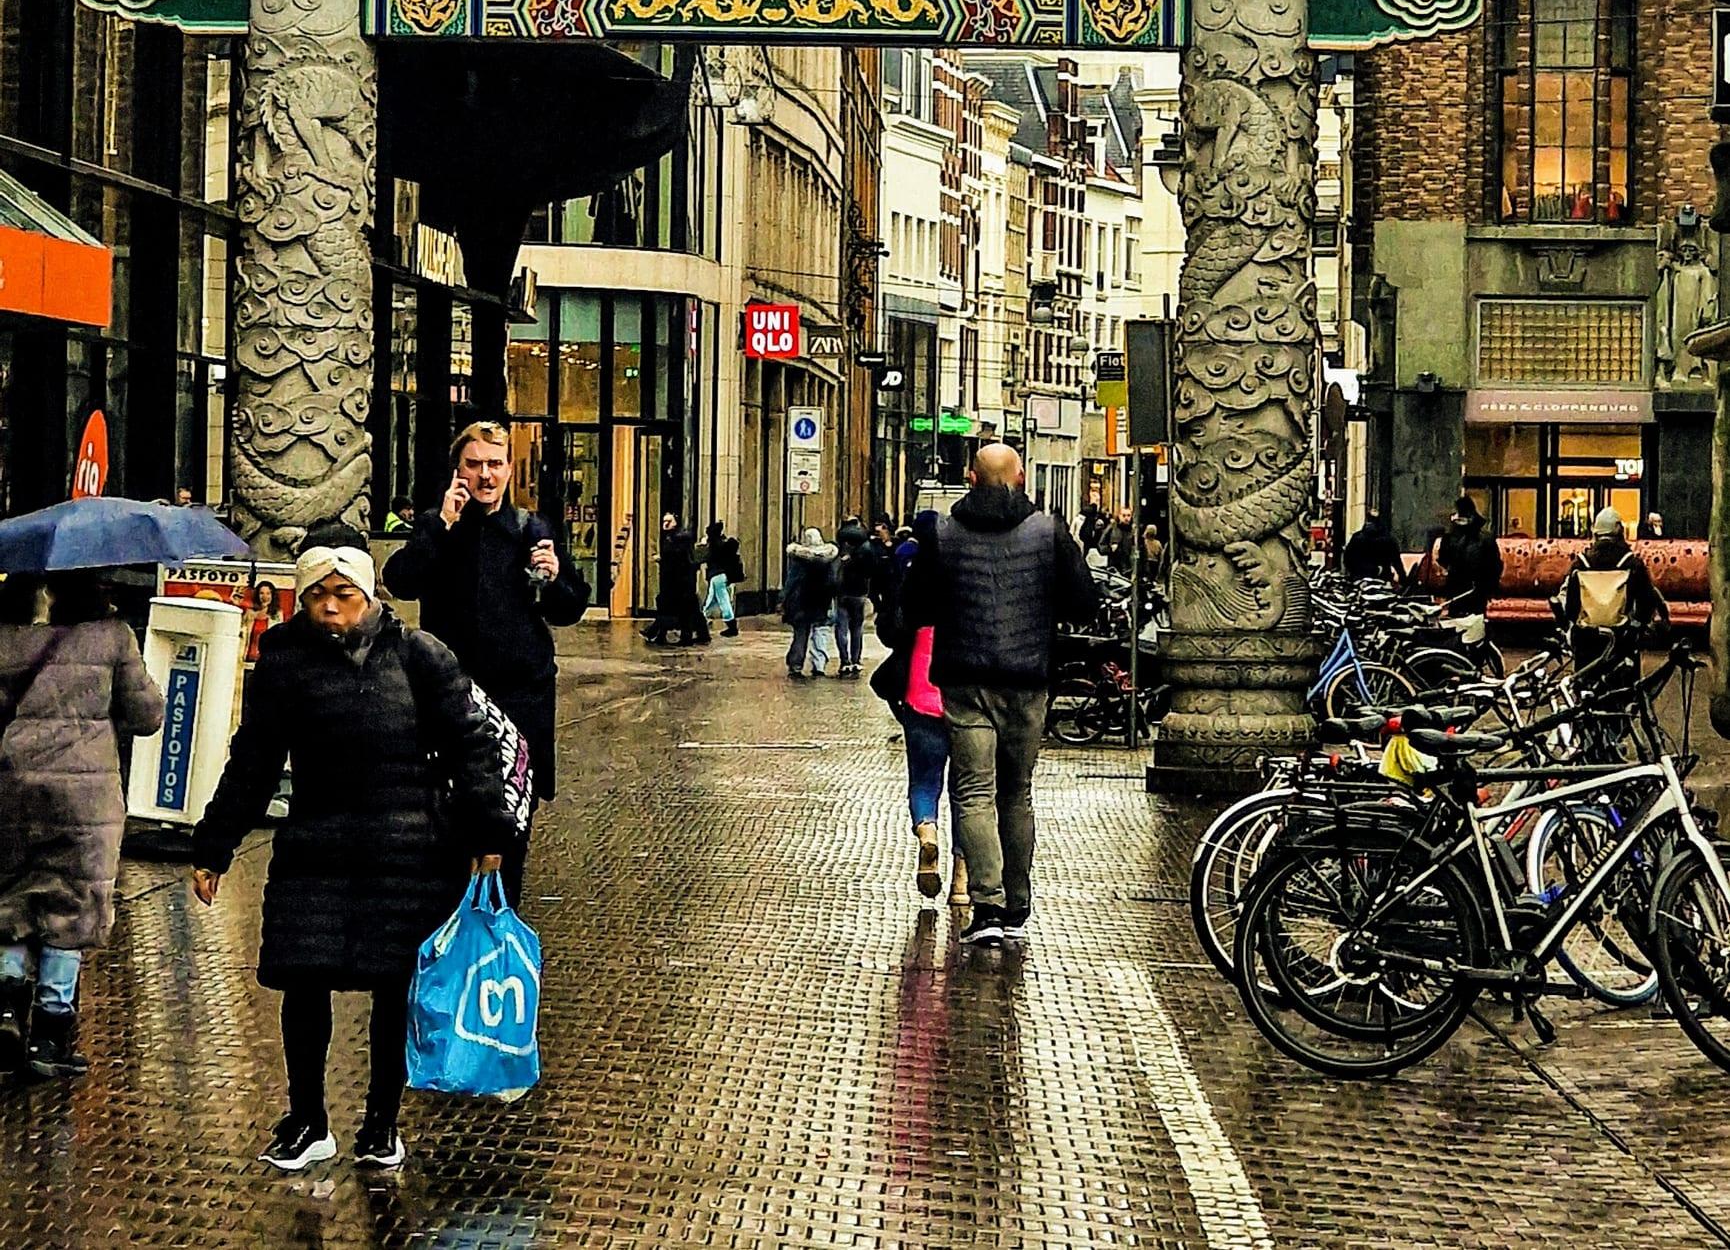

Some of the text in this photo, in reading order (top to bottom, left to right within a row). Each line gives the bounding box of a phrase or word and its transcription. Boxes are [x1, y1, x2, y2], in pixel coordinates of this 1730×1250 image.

[752, 311, 790, 331] UNI
[752, 332, 793, 354] QLO
[810, 336, 844, 353] ZARA
[881, 371, 903, 386] JD
[163, 675, 187, 803] PASFOTOS
